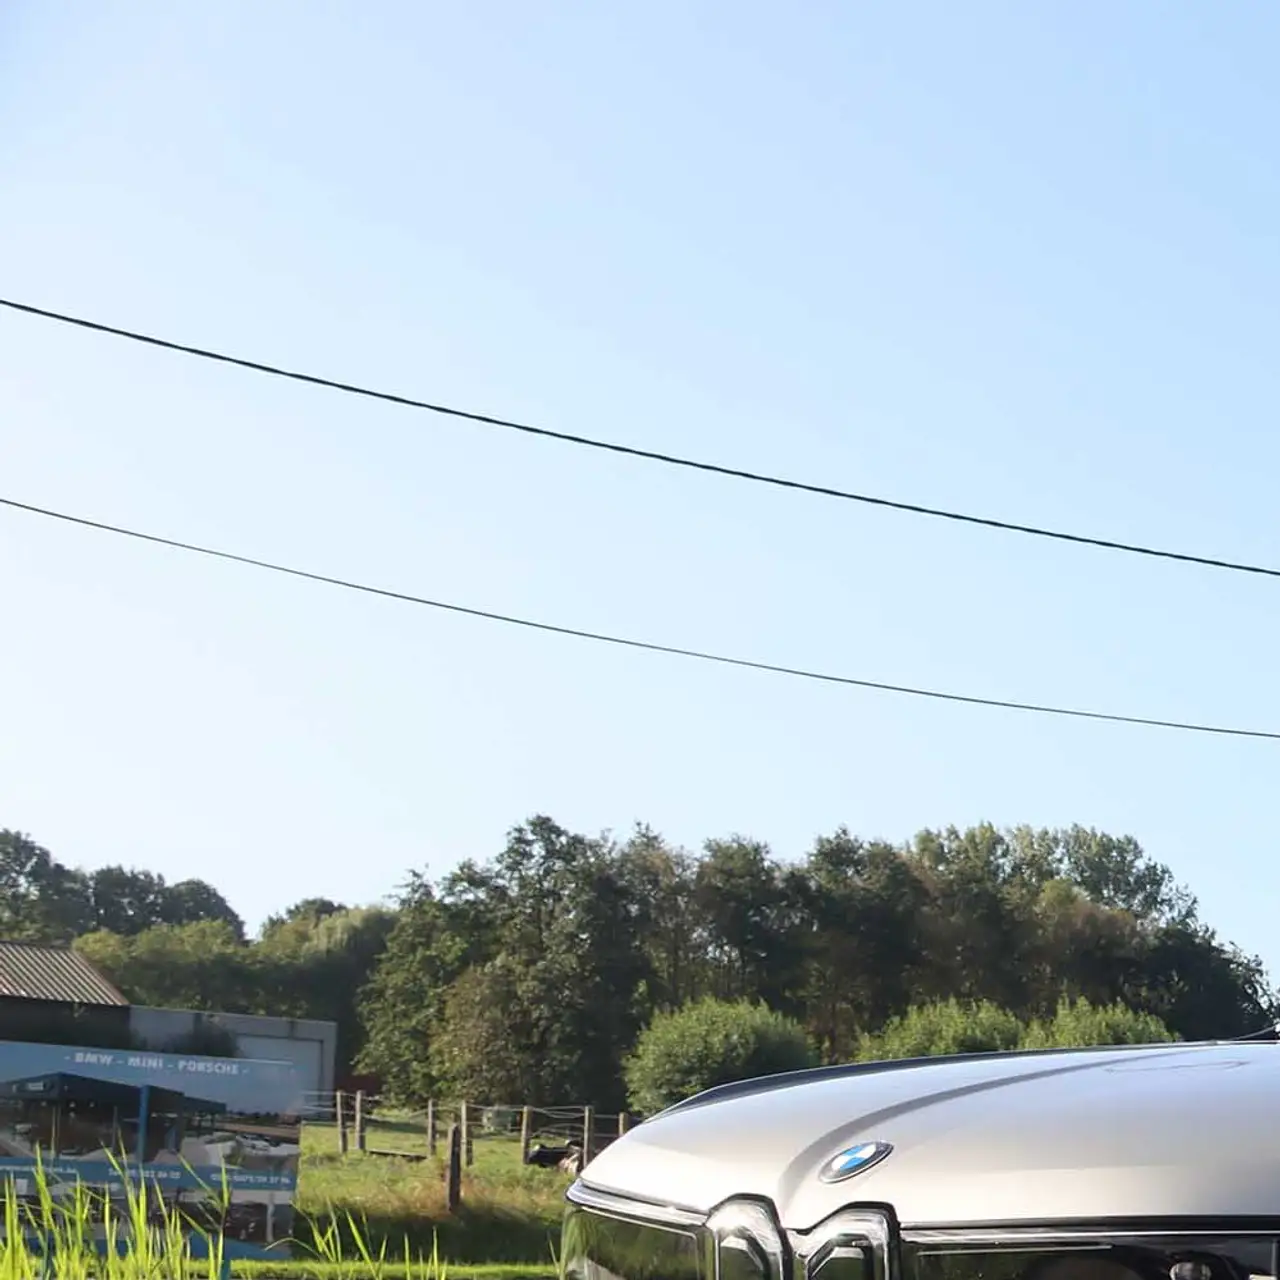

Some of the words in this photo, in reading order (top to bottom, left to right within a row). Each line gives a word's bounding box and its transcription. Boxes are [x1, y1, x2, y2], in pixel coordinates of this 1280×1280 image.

[75, 1052, 114, 1066] BMW
[128, 1056, 164, 1069] MINI
[178, 1059, 239, 1074] PORSCHE
